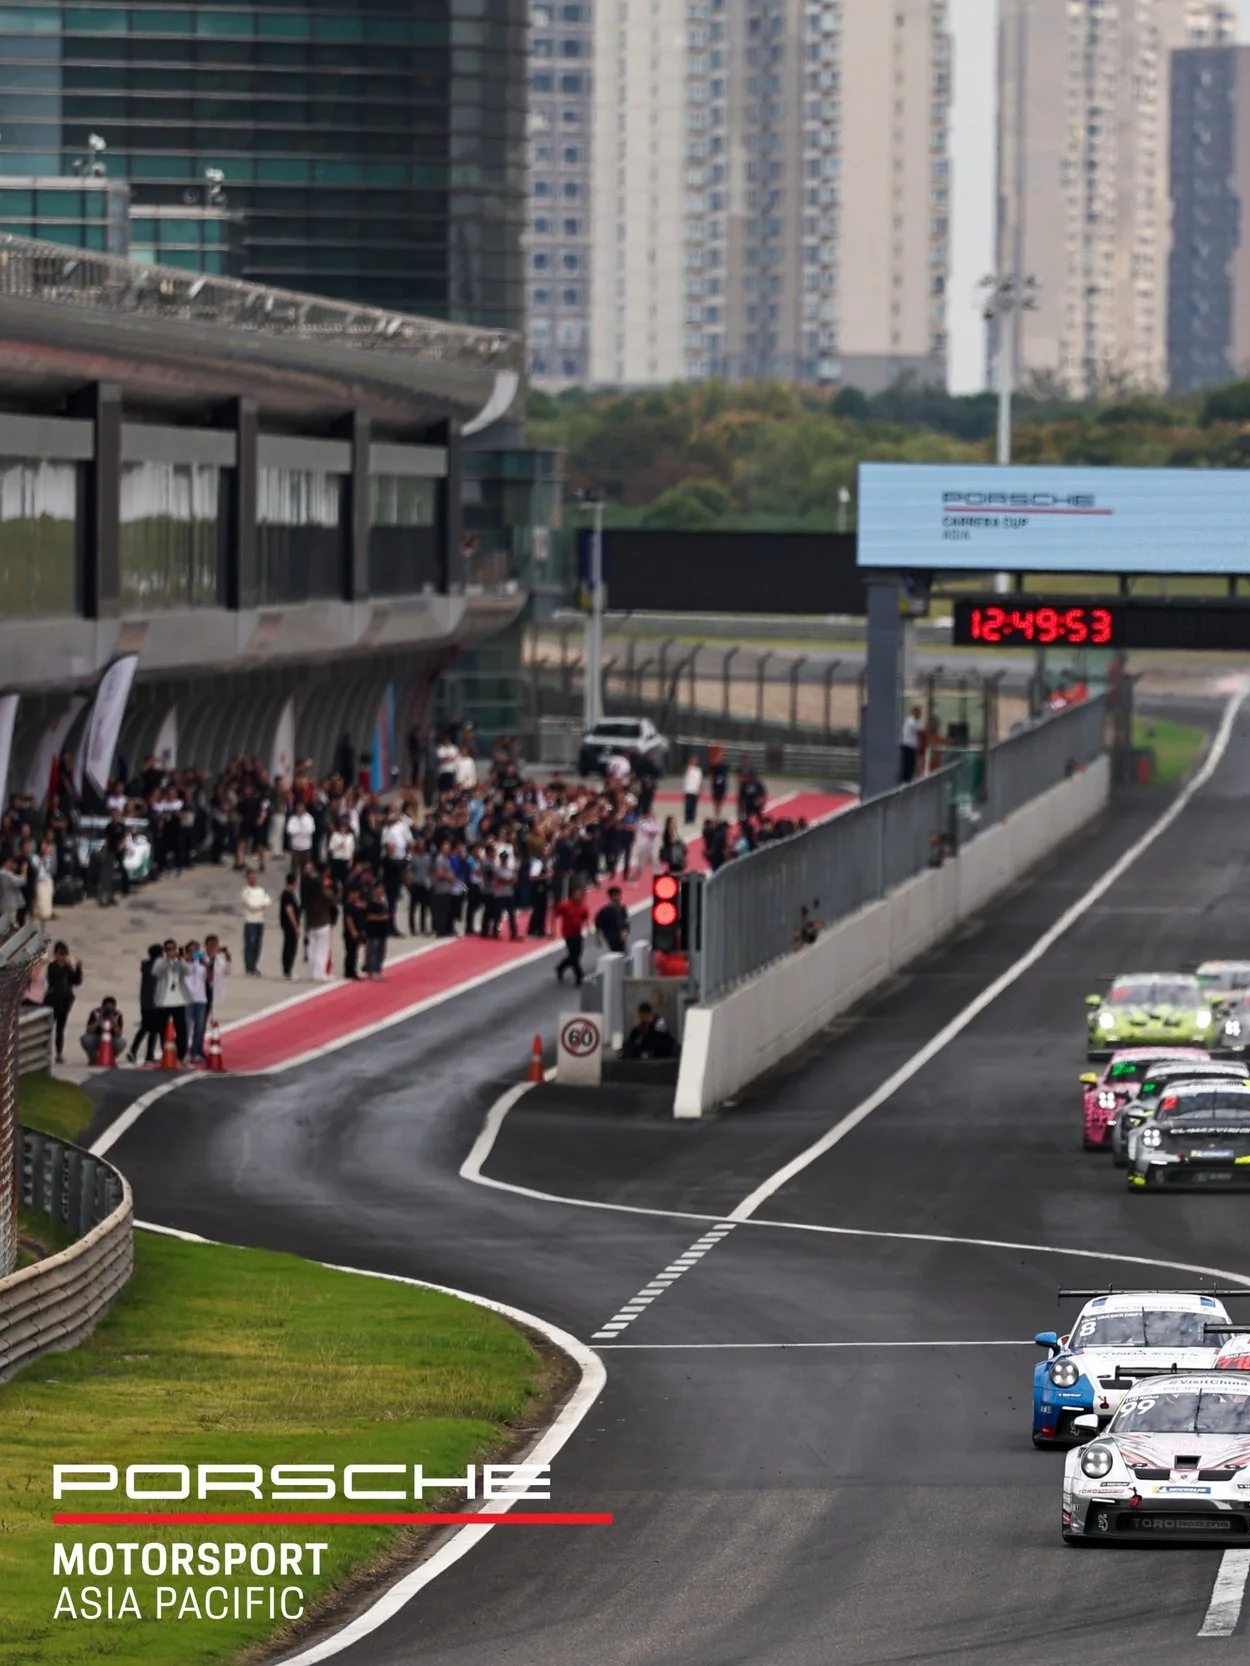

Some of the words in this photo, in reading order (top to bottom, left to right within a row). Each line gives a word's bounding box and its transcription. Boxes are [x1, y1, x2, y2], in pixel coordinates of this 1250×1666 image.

[943, 492, 1095, 507] PORSCHE
[971, 606, 1113, 643] 12:49:53
[569, 1028, 593, 1047] 60
[1079, 1321, 1097, 1337] 8
[1119, 1399, 1156, 1418] 99
